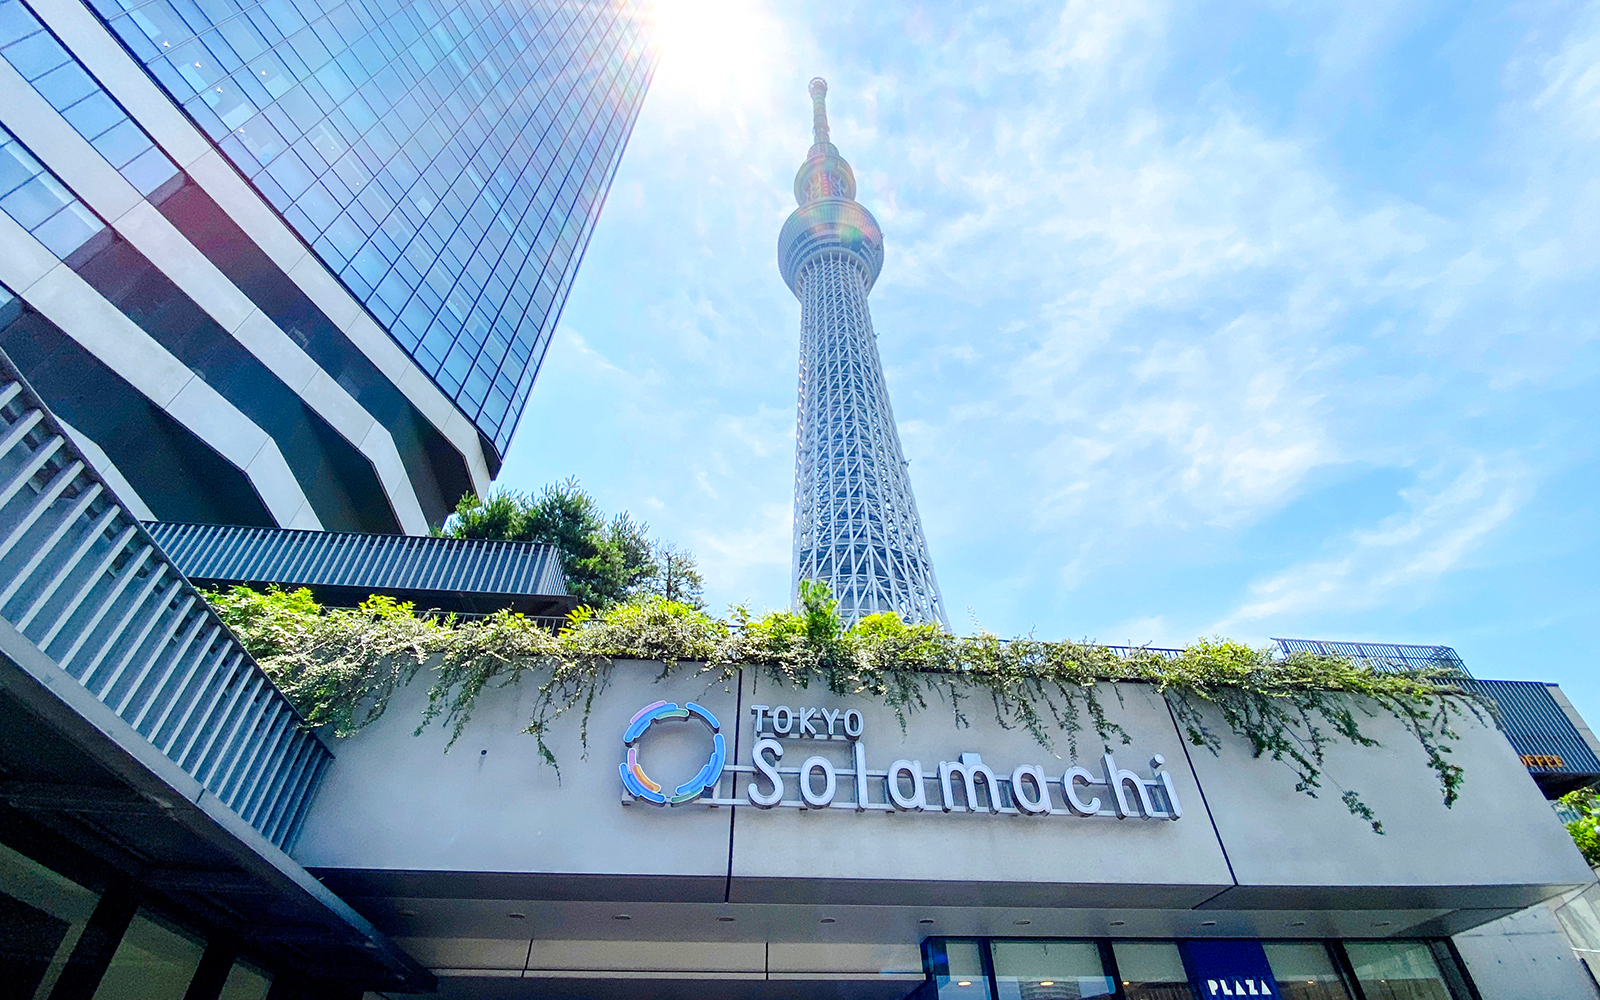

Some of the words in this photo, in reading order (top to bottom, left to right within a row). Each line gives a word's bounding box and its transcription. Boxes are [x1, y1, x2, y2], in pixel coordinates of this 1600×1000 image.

[750, 704, 864, 739] TOKYO
[747, 738, 1183, 821] Solamachi
[1207, 979, 1272, 996] PLAZA
